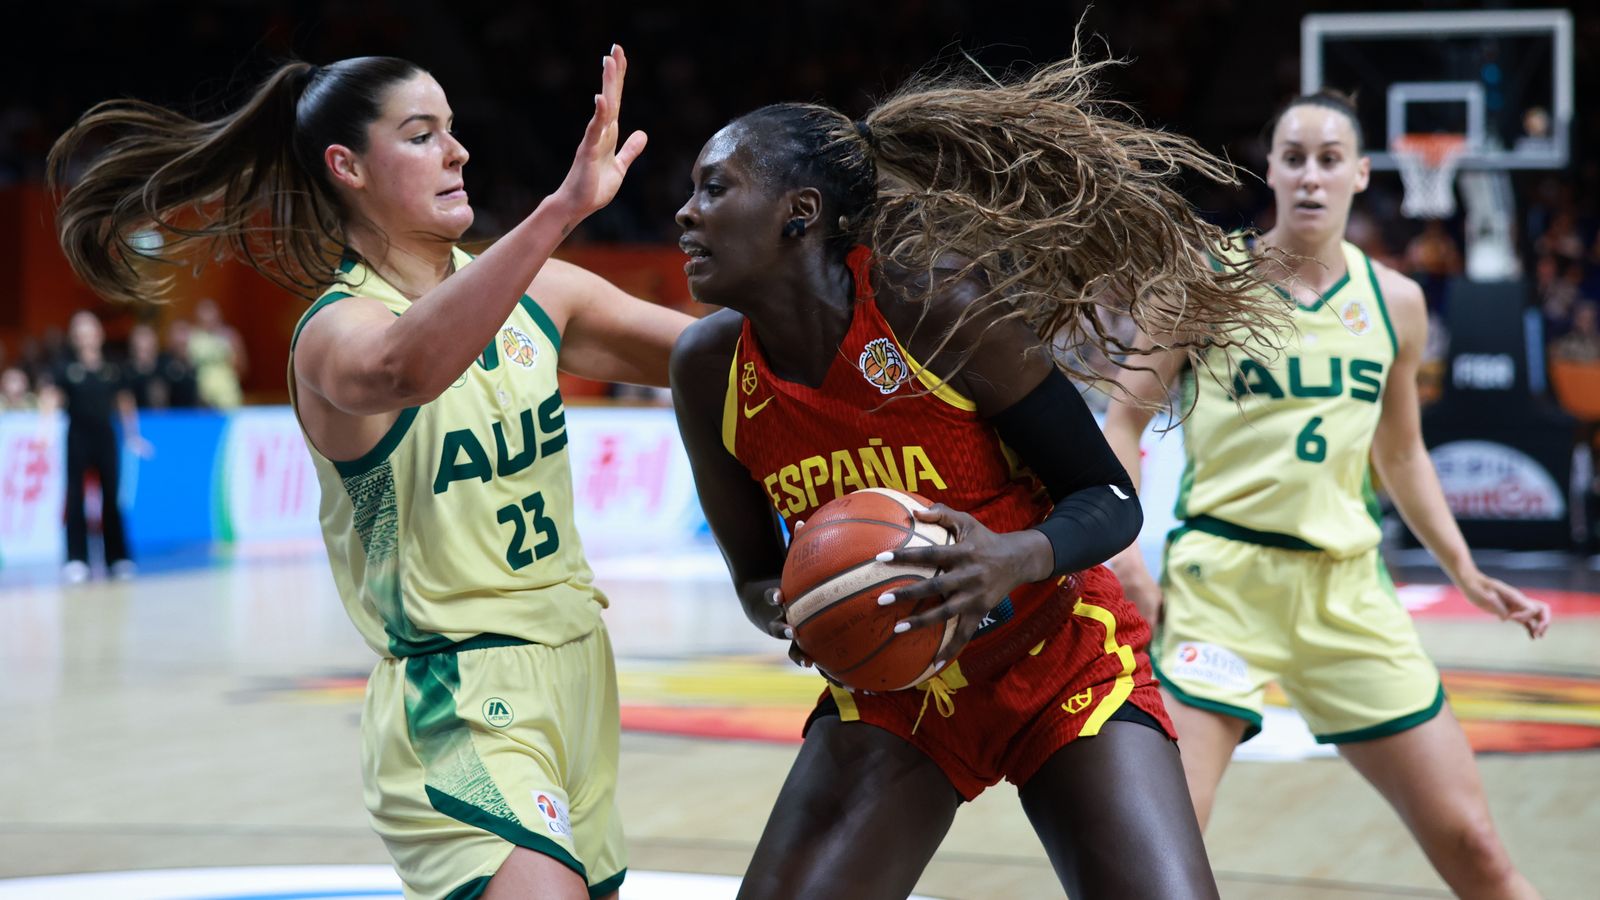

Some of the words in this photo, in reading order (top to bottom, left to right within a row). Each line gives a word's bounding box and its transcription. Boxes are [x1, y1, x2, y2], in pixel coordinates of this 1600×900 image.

[1227, 357, 1383, 403] AUS
[433, 389, 568, 494] AUS
[764, 438, 948, 519] ESPAÑA
[1295, 416, 1328, 463] 6
[496, 491, 560, 571] 23
